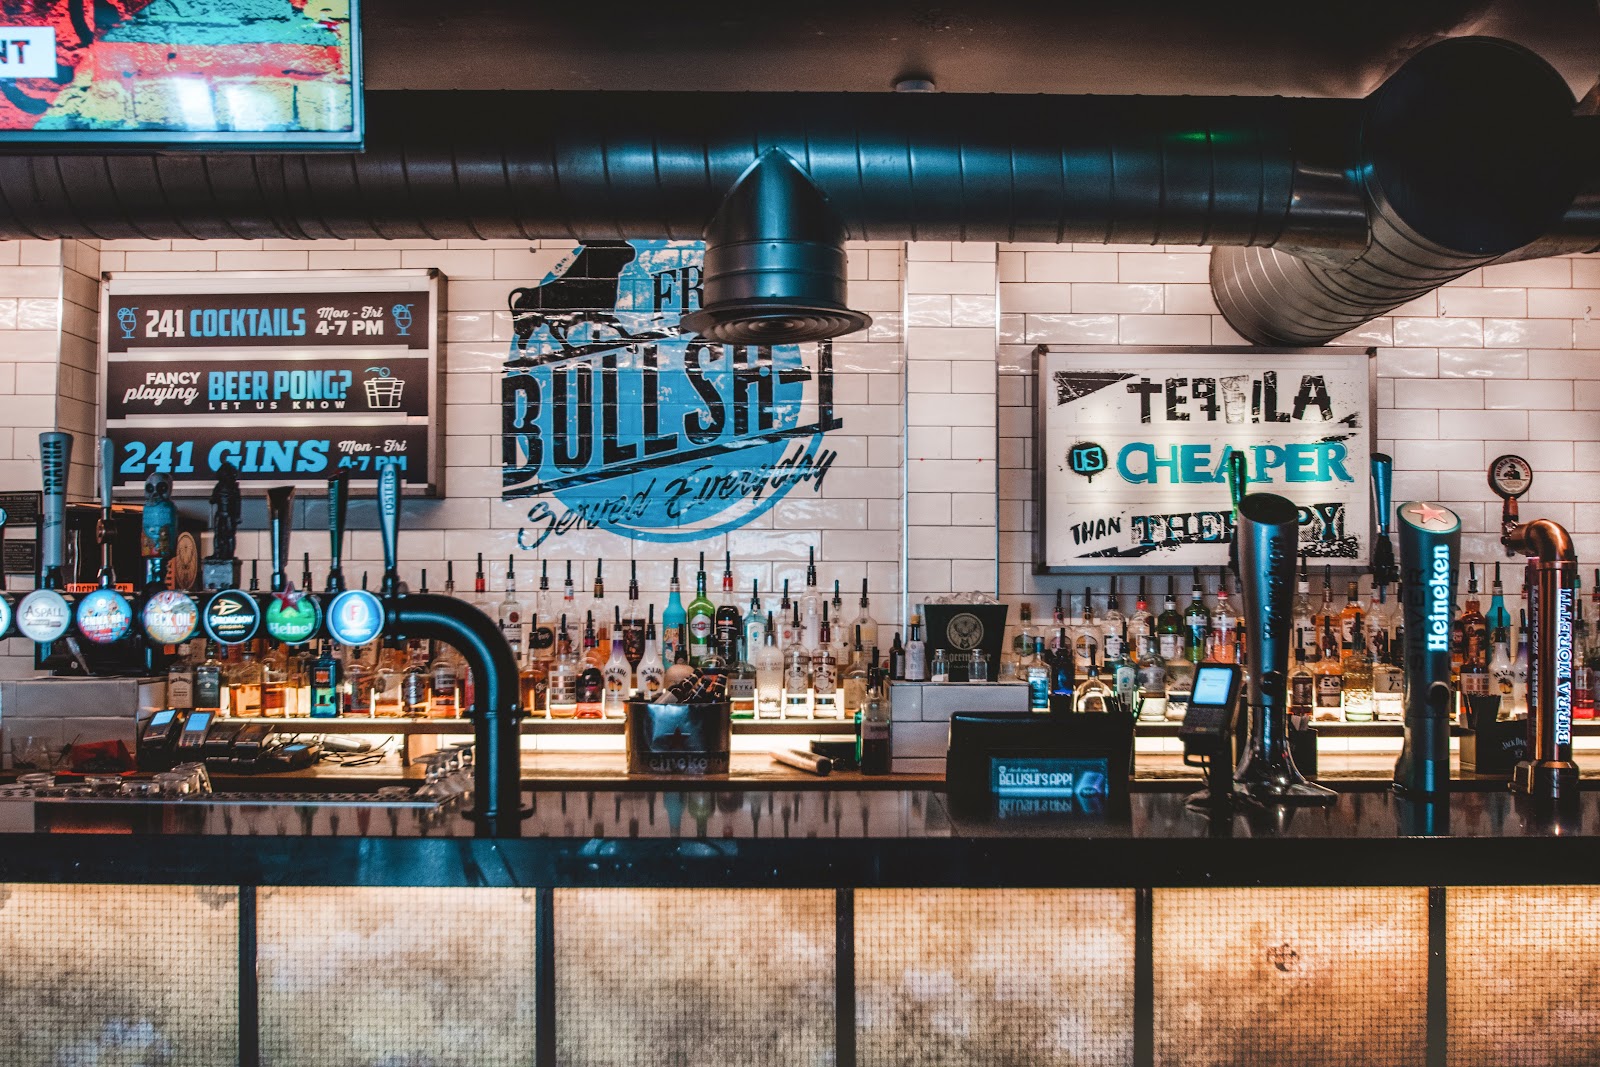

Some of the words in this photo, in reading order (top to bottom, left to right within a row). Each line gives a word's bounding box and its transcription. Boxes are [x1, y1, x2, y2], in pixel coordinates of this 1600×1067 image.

[145, 309, 185, 338] 241
[190, 308, 306, 337] COCKTAILS
[316, 306, 350, 320] Mon
[360, 306, 384, 319] Fri
[315, 320, 347, 335] 4-7
[352, 320, 384, 335] PM
[146, 372, 201, 385] FANCY
[208, 370, 269, 401] BEER
[274, 369, 353, 400] PONG?
[123, 384, 200, 406] playing
[209, 402, 241, 410] LET
[256, 401, 278, 410] US
[293, 400, 346, 410] KNOW
[120, 441, 194, 474] 241
[208, 440, 330, 473] GINS
[338, 440, 373, 455] Mon
[383, 440, 407, 453] Fri
[1076, 448, 1101, 469] IS
[517, 477, 656, 551] Served
[664, 445, 838, 520] Everyday
[1070, 516, 1122, 545] THAN
[1427, 544, 1449, 652] Heineken
[176, 613, 192, 626] OIL
[1556, 588, 1572, 679] MORETTI
[1556, 682, 1572, 745] BIRRA
[999, 773, 1048, 785] BELUSHI'S
[1049, 773, 1073, 785] APP!
